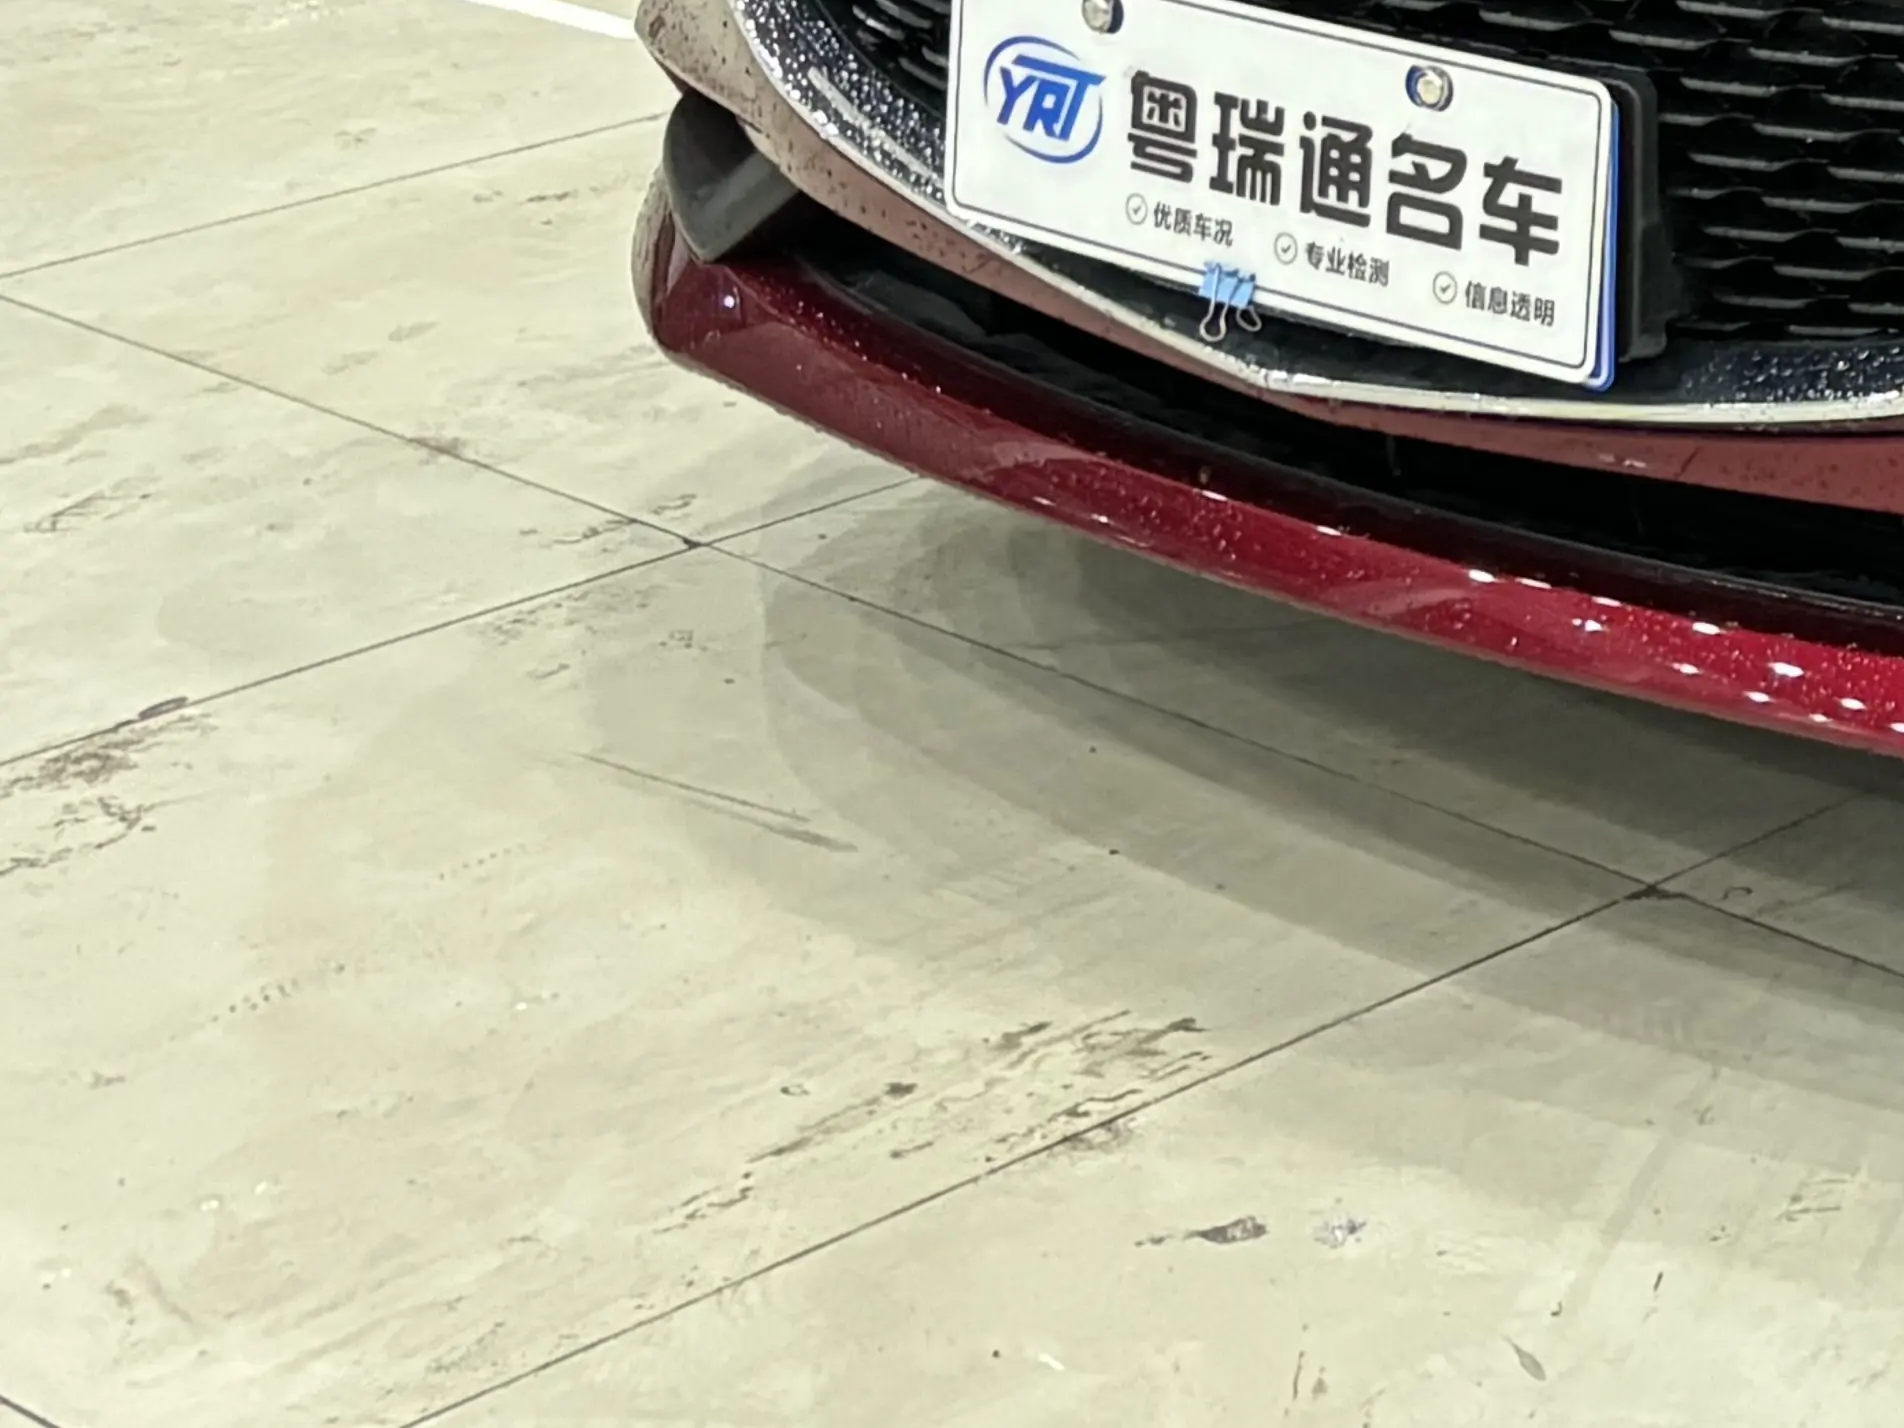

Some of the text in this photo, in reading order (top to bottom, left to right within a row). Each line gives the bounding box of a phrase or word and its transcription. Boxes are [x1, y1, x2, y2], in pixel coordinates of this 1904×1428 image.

[997, 55, 1107, 142] YRT
[1126, 70, 1561, 266] 粤瑞通名车
[1153, 201, 1557, 329] 优质车况 专业检测 信息透明
